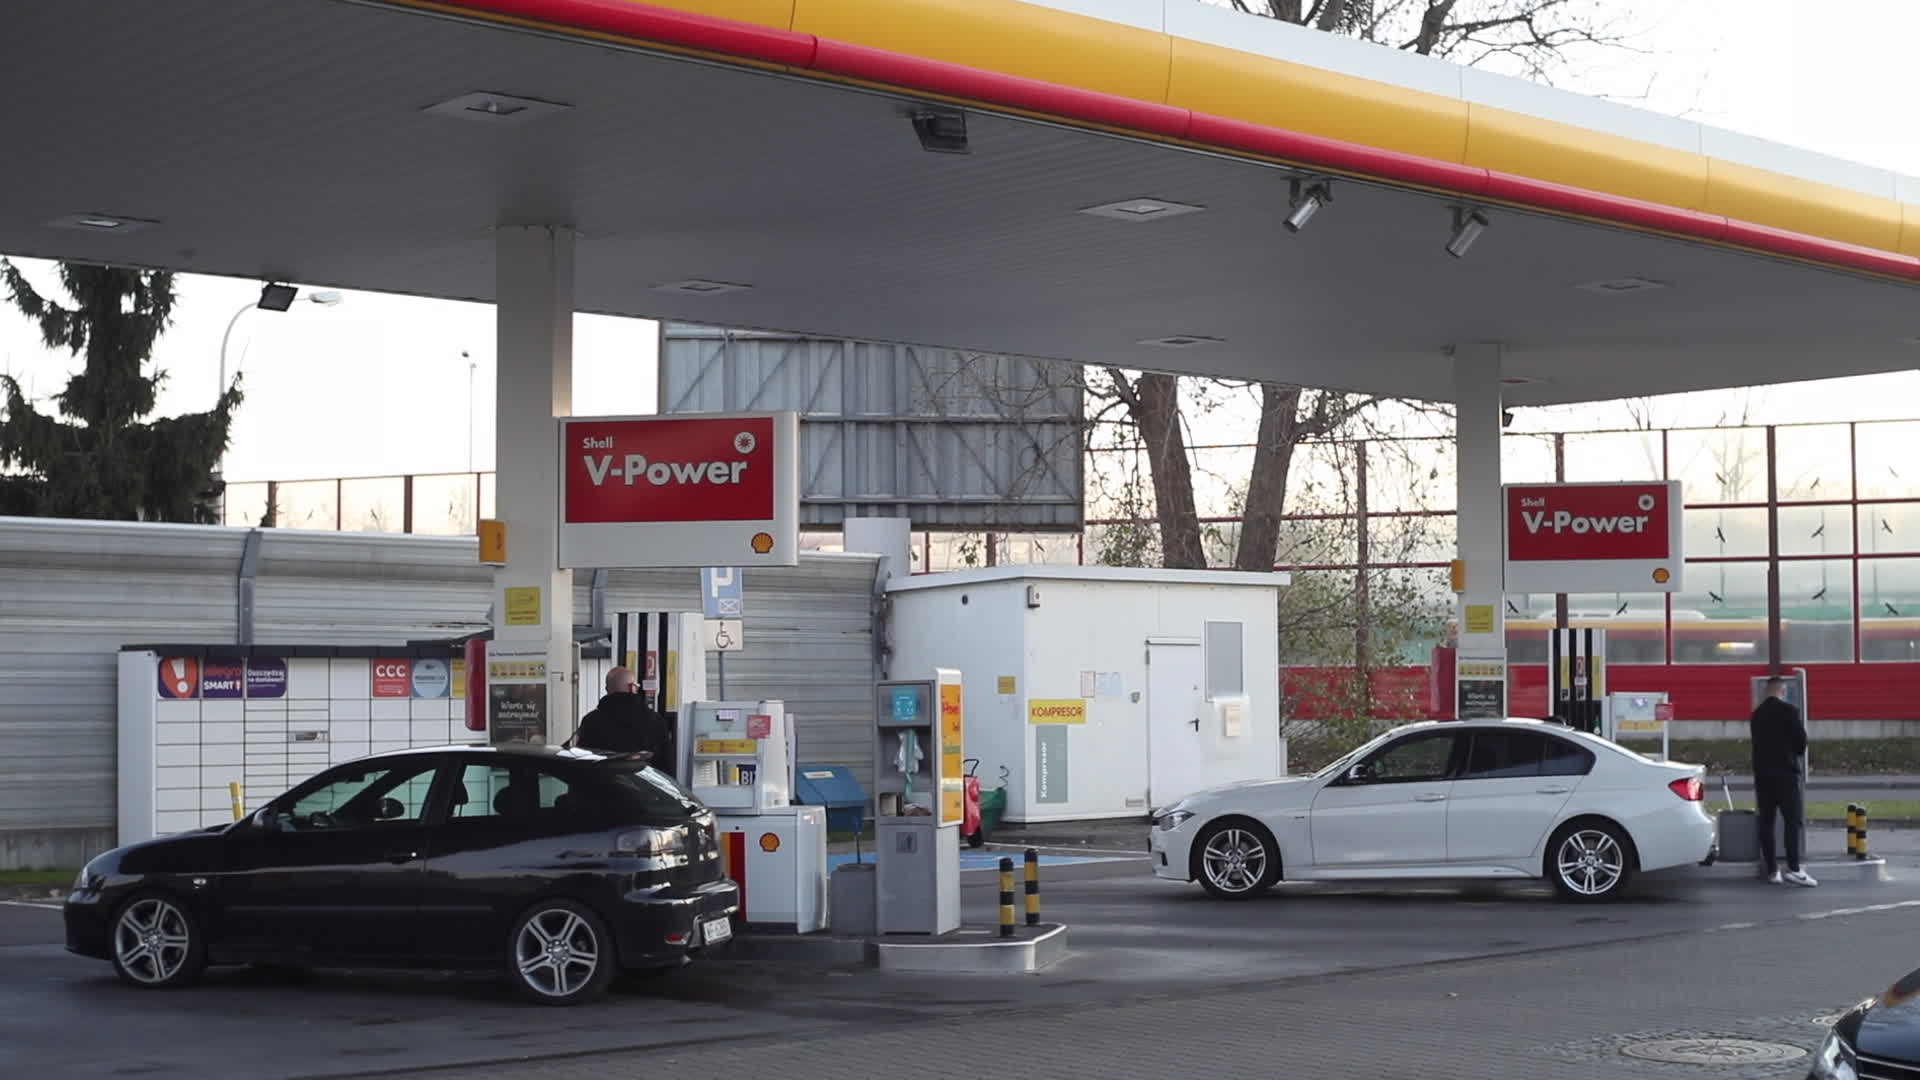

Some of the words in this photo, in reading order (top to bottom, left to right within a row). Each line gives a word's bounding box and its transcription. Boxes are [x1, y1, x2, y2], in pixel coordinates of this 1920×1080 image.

[583, 436, 614, 449] Shell
[583, 454, 748, 486] V-Power
[1521, 497, 1545, 507] Shell
[1521, 510, 1649, 534] V-Power
[711, 567, 734, 598] P
[375, 664, 406, 678] CCC
[1031, 705, 1083, 718] KOMPRESOR
[1040, 740, 1048, 799] Kompresor
